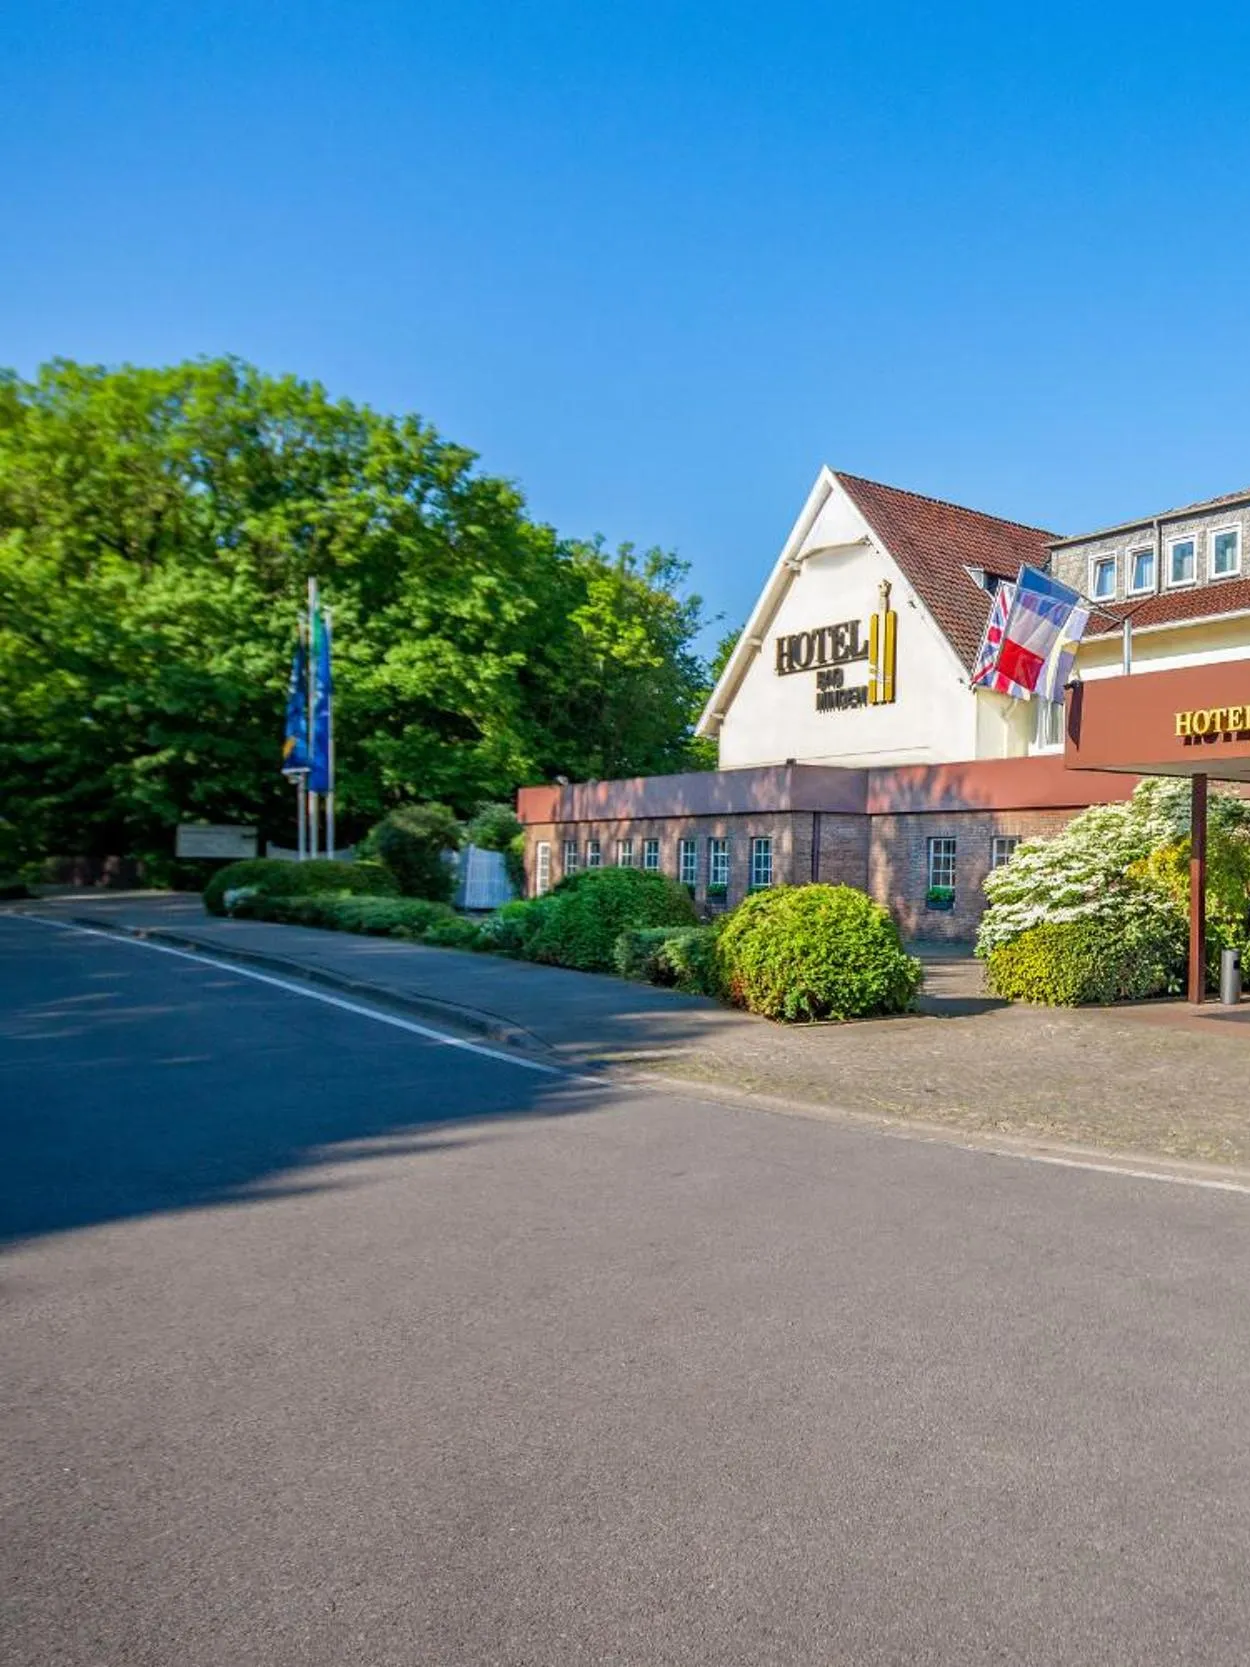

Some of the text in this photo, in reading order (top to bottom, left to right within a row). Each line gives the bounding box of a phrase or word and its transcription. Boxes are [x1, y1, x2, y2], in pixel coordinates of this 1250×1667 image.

[774, 619, 869, 673] HOTEL
[816, 667, 844, 690] BAD
[816, 685, 868, 712] MINDEN
